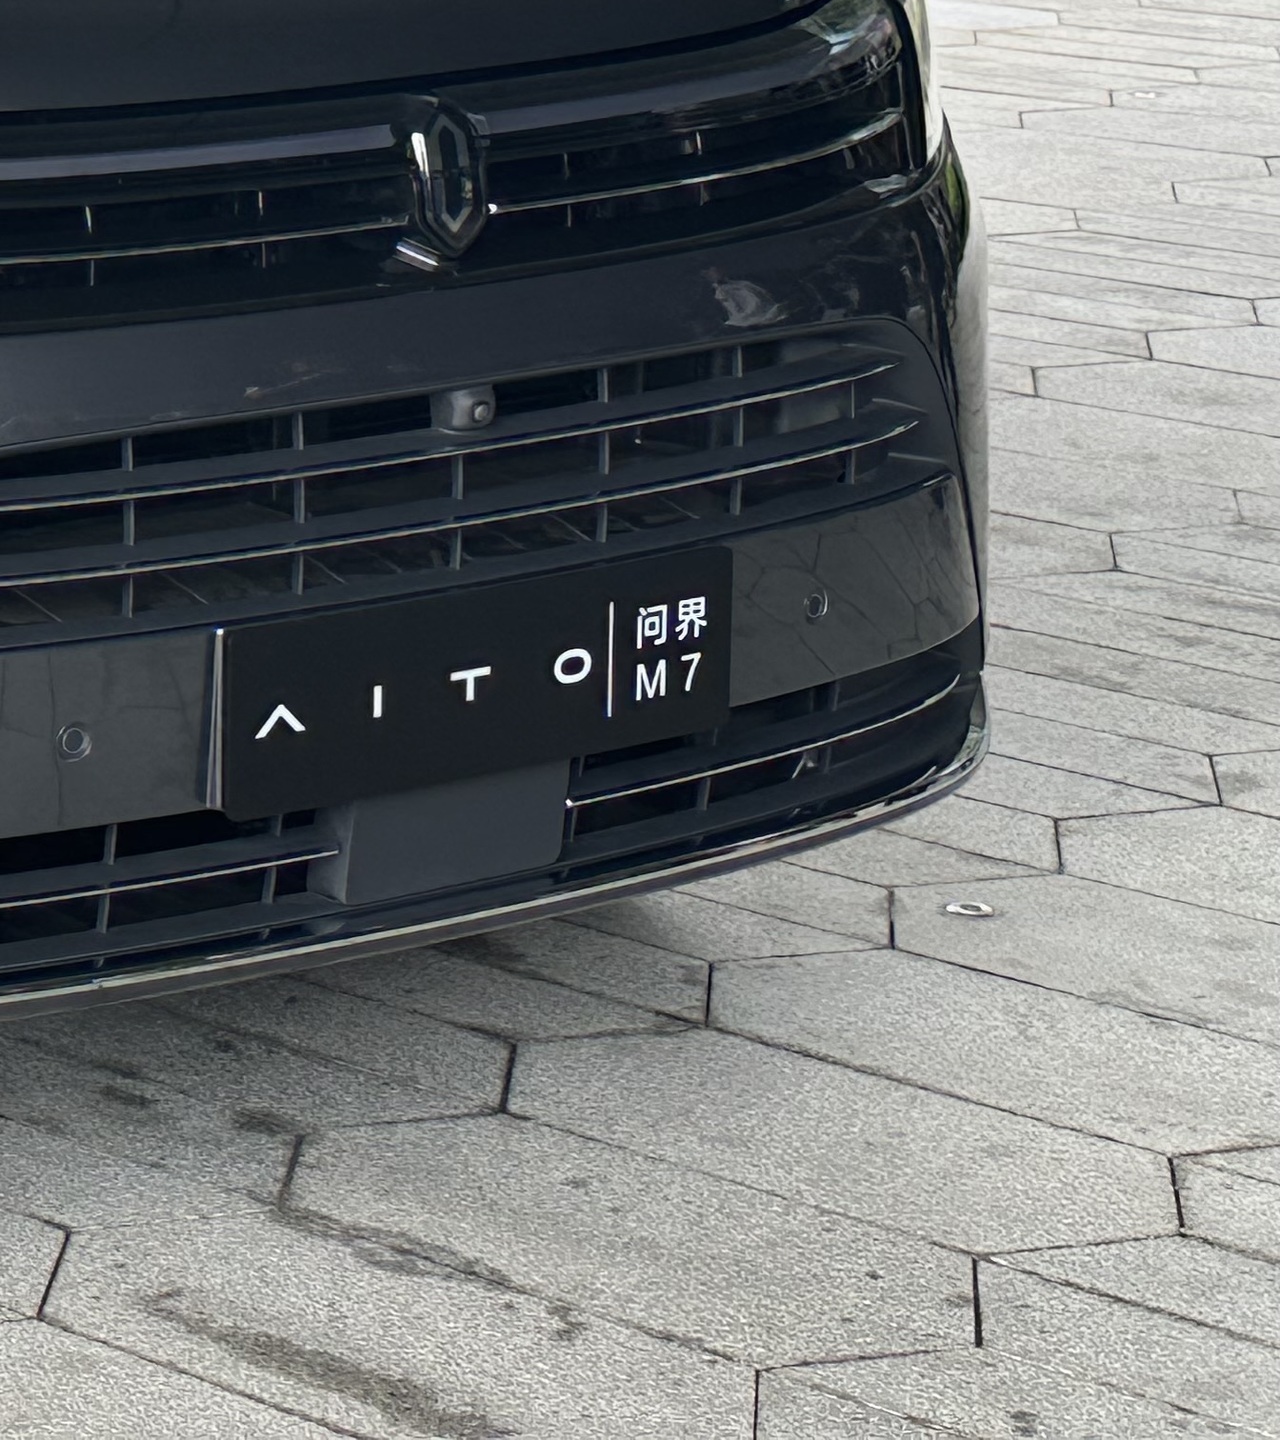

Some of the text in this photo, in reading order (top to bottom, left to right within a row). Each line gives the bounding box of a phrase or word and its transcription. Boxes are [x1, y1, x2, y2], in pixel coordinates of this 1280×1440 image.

[635, 595, 708, 650] 问界
[254, 646, 592, 740] AITO
[635, 651, 702, 702] M7
